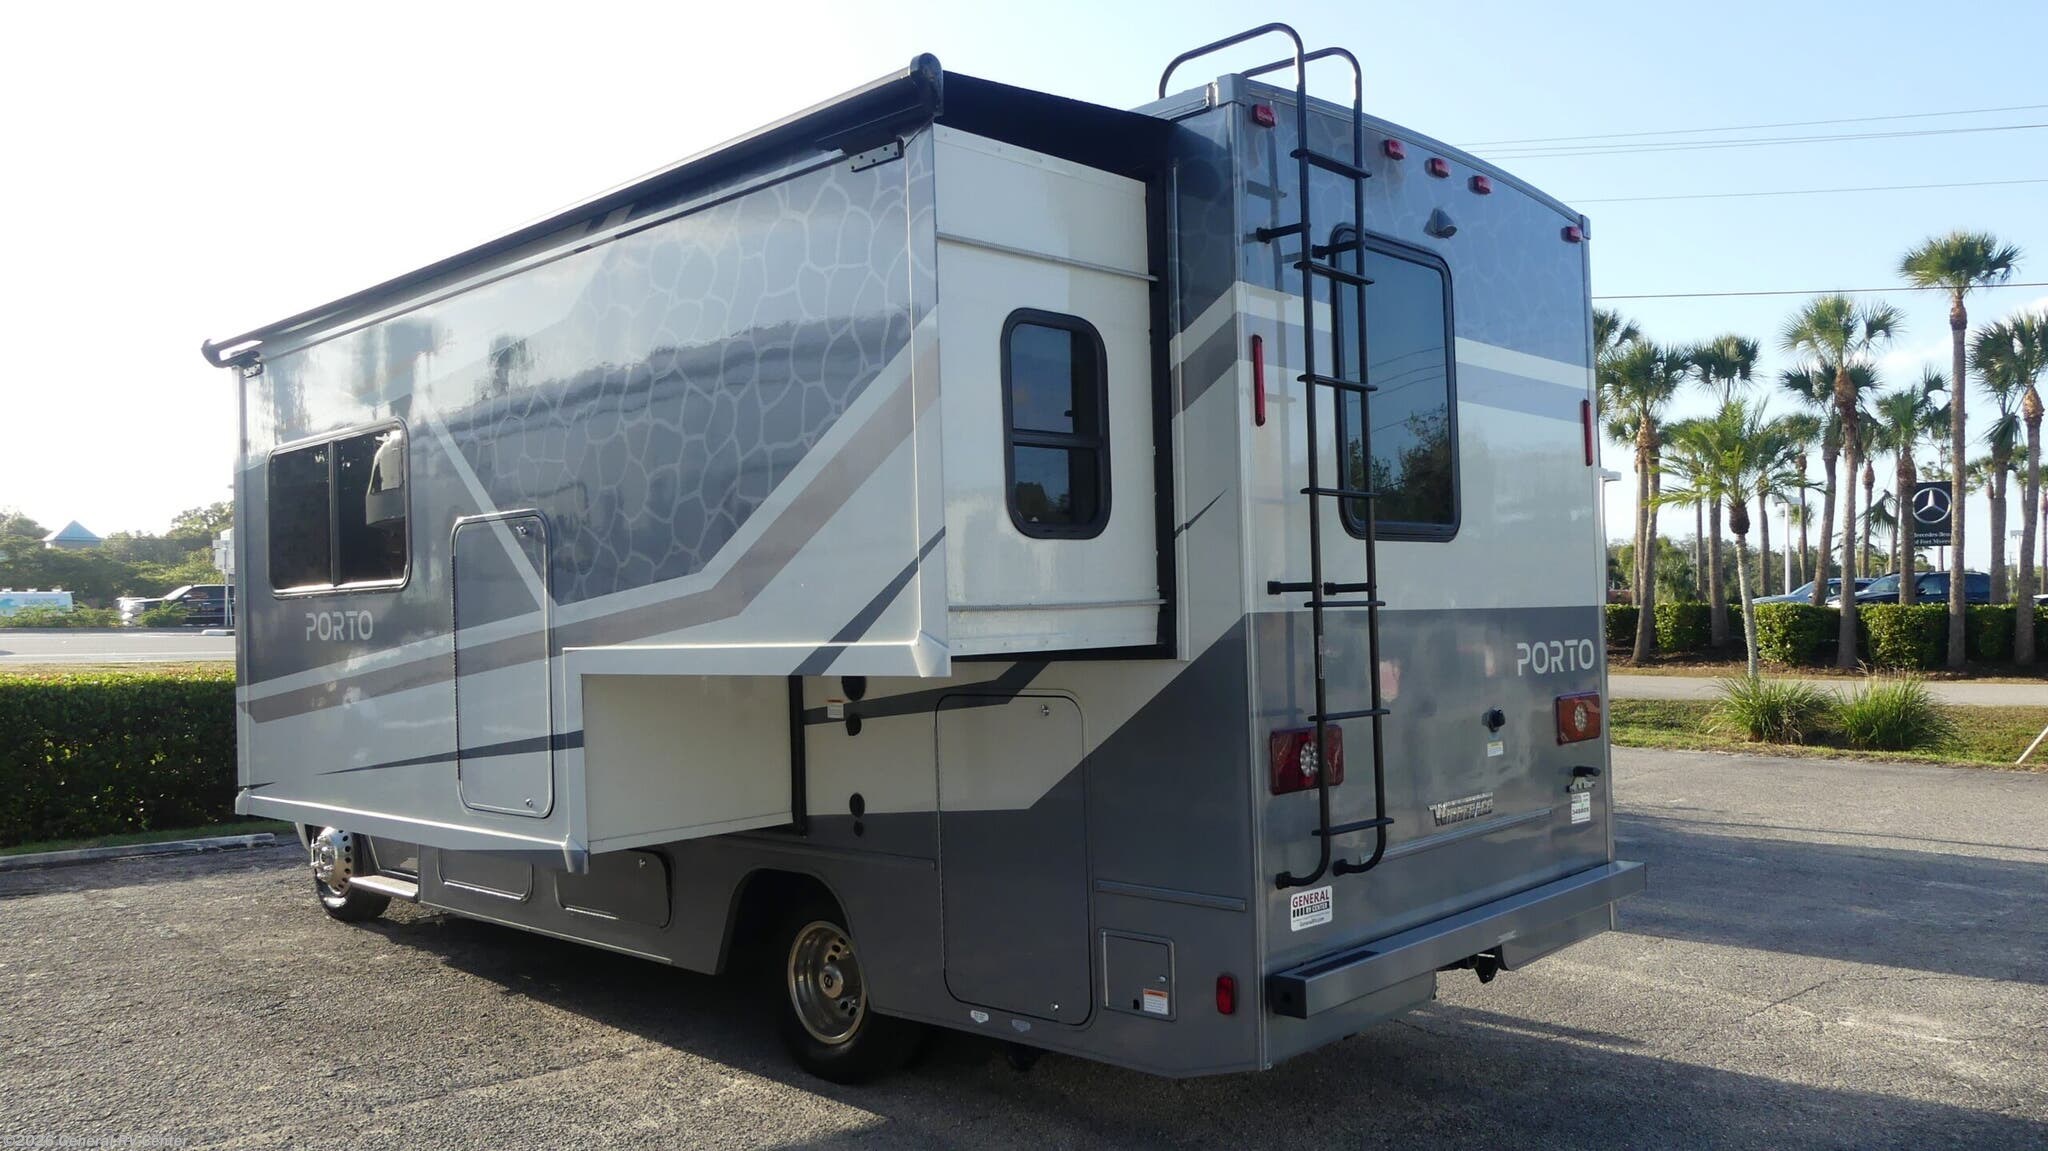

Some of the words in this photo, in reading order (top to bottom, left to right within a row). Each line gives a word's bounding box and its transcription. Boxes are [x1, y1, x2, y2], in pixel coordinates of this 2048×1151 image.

[305, 610, 373, 641] PORTO
[1516, 639, 1595, 677] PORTO
[1292, 889, 1330, 908] GENERAL
